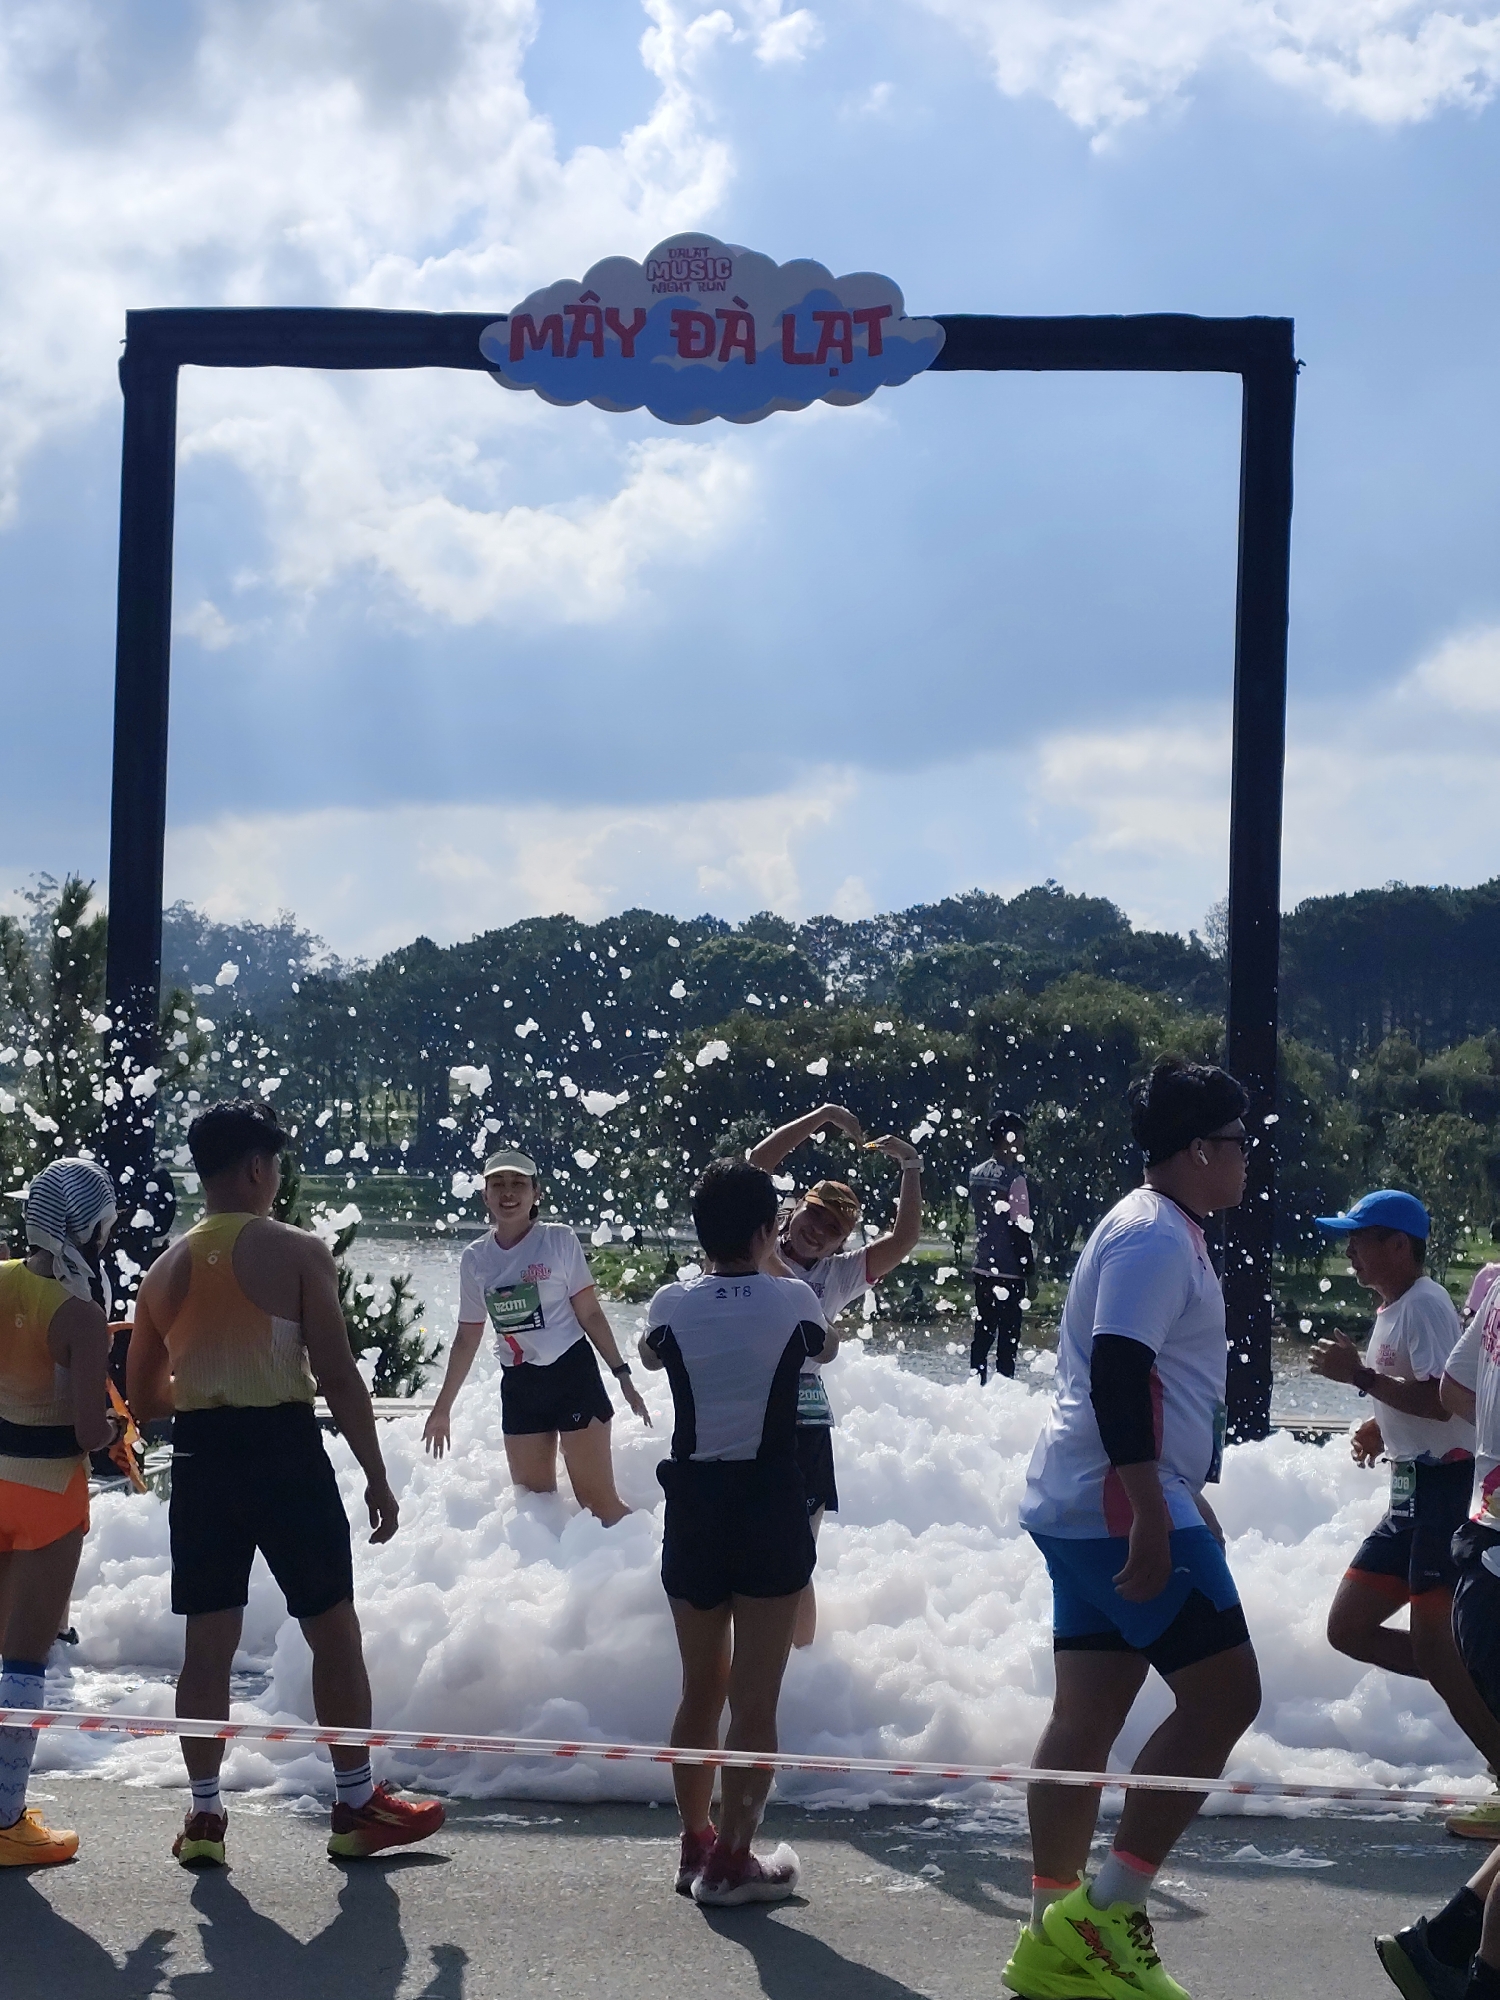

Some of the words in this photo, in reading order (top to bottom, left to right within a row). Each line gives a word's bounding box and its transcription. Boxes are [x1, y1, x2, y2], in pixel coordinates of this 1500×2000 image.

[667, 247, 709, 258] DALAT
[647, 257, 732, 281] MUSIC
[652, 282, 690, 294] NIGHT
[698, 281, 726, 292] RUN
[509, 289, 647, 362] MÂY
[670, 295, 756, 364] ĐÀ
[782, 304, 893, 377] LẠT
[731, 1285, 752, 1298] T8
